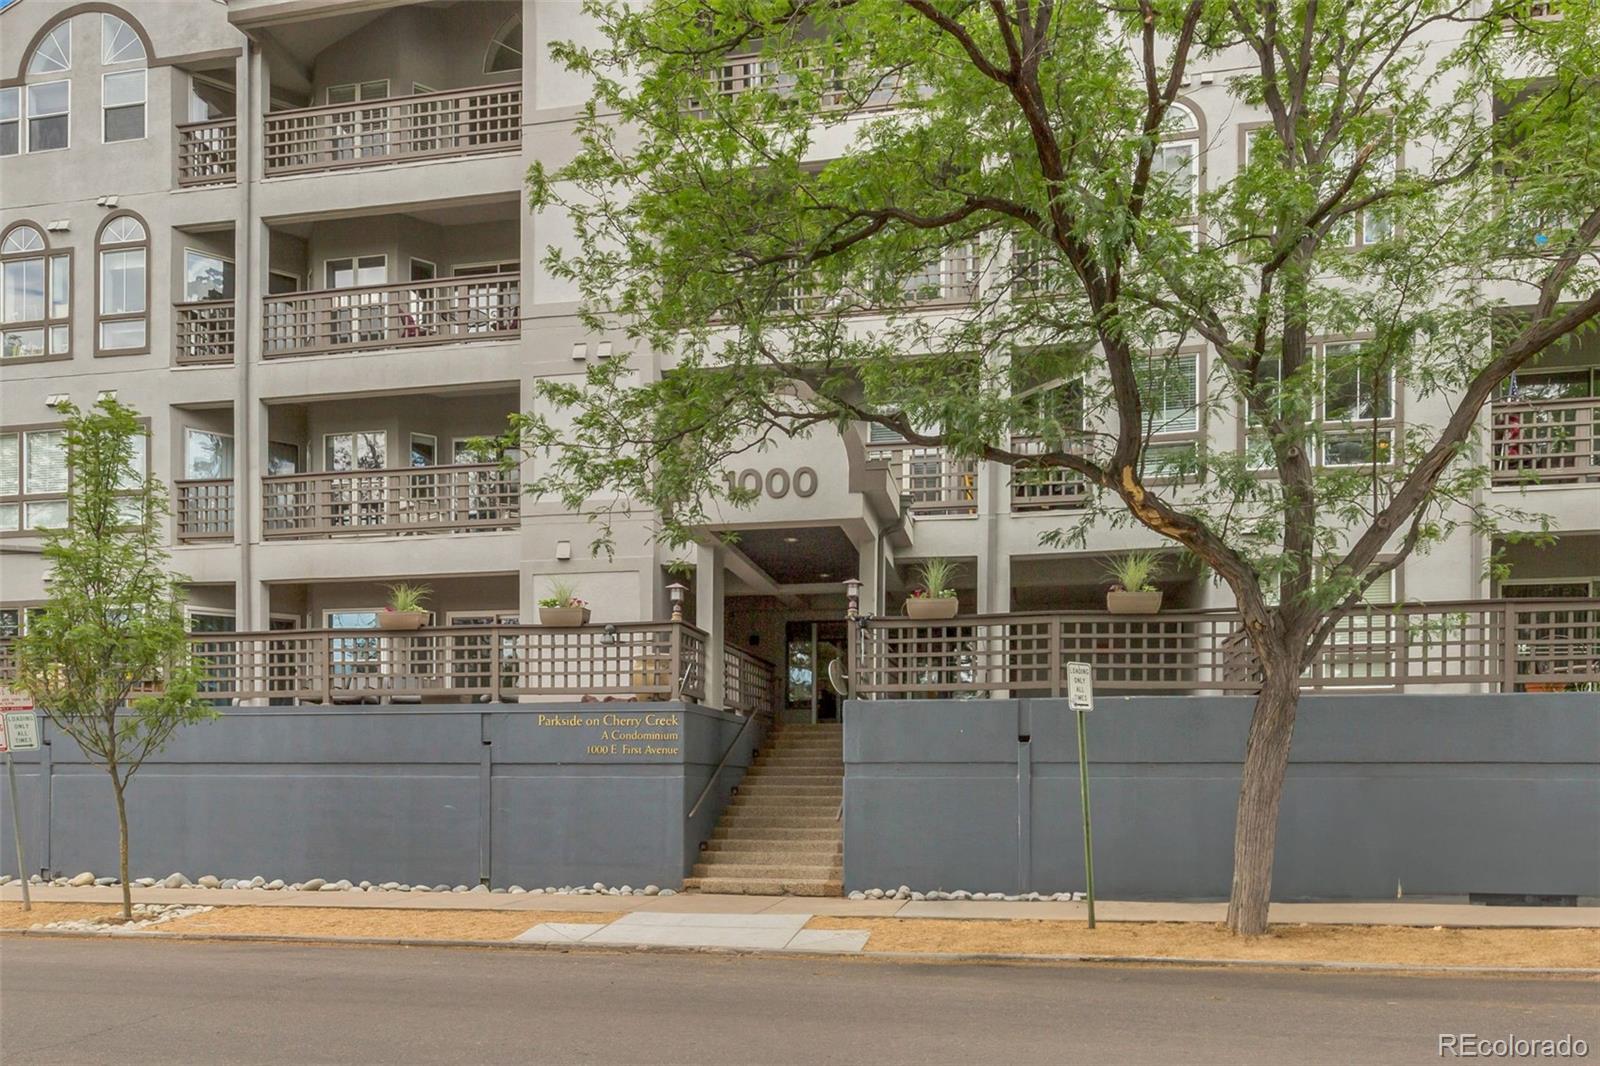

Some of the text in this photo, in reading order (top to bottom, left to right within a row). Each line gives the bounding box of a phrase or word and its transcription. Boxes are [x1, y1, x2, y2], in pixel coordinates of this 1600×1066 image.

[721, 466, 818, 499] 1000
[538, 714, 679, 728] Parkside on Cherry Creek
[601, 730, 679, 741] A Condominium
[586, 745, 609, 755] 1000
[622, 744, 642, 755] First
[644, 744, 679, 755] Avenue
